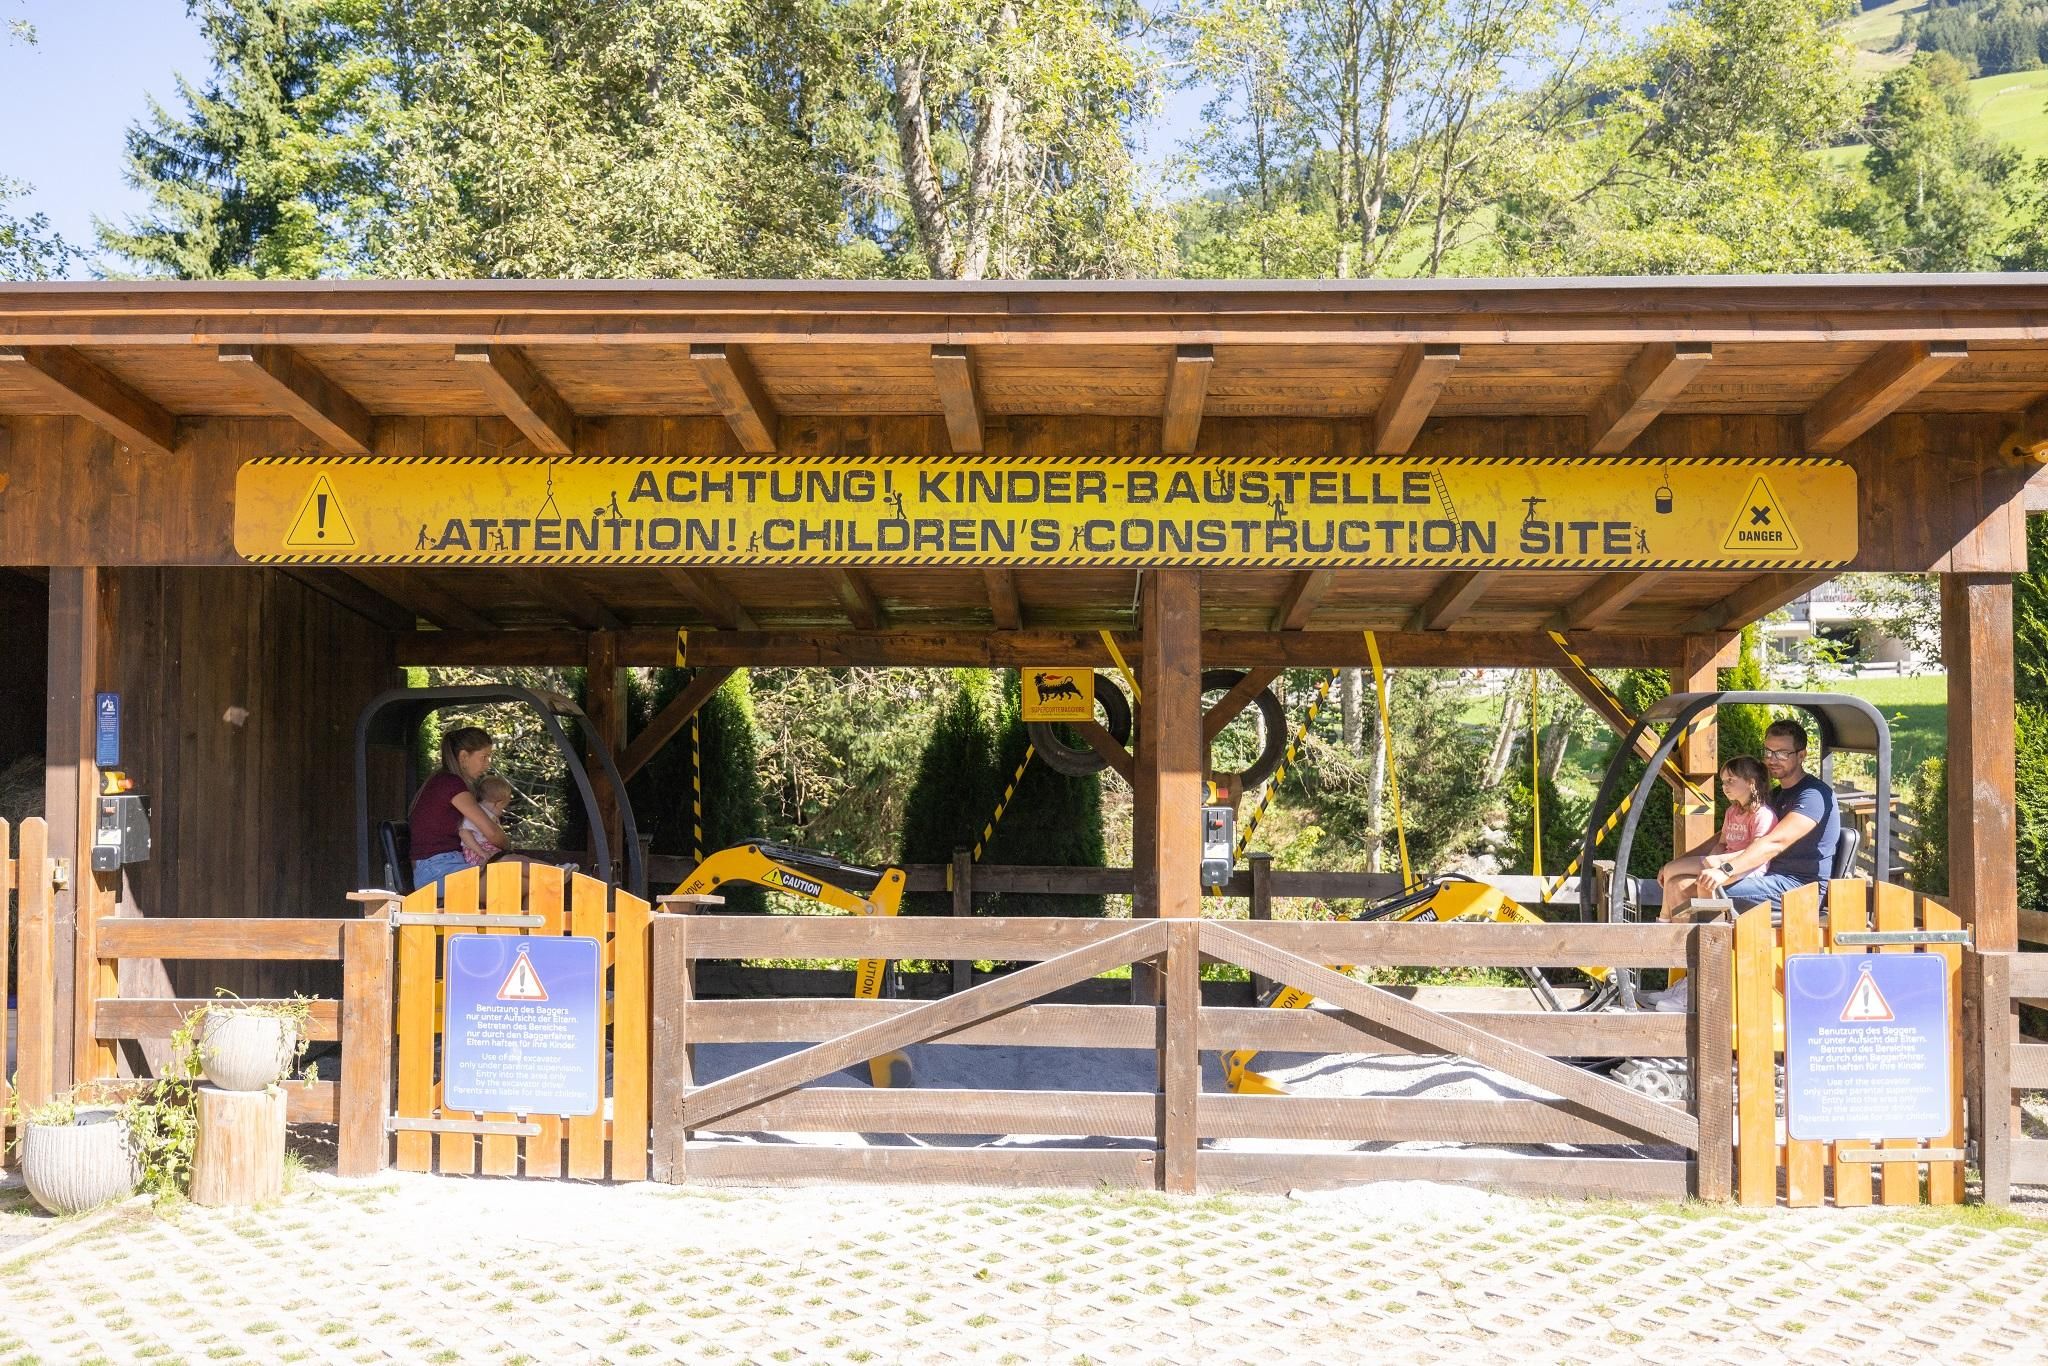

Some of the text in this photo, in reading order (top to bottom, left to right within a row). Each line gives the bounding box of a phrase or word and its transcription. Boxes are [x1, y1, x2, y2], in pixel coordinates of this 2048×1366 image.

[628, 469, 1431, 504] ACHTUNG! KINDER-BAUSTELLE
[436, 517, 1632, 555] ATTENTION! CHILDREN'S CONSTRUCTION SITE
[1739, 530, 1783, 542] DANGER
[782, 875, 821, 896] CAUTION
[476, 1004, 518, 1015] Benutzung
[537, 1006, 568, 1016] Baggers
[504, 1014, 536, 1022] Aufsicht
[513, 1022, 526, 1030] des
[529, 1023, 568, 1031] Bereiches
[1819, 1027, 1863, 1037] Benutzung
[1883, 1026, 1916, 1035] Baggers
[467, 1038, 489, 1046] Eltern
[492, 1039, 518, 1047] haften
[1849, 1035, 1883, 1043] Aufsicht
[1885, 1035, 1898, 1043] der
[1821, 1045, 1856, 1053] Betreten
[1876, 1044, 1915, 1052] Bereiches
[499, 1053, 507, 1061] of
[1826, 1054, 1850, 1062] durch
[1852, 1053, 1867, 1061] den
[503, 1063, 534, 1071] parental
[1810, 1063, 1834, 1072] Eltern
[1837, 1062, 1864, 1071] haften
[1866, 1062, 1877, 1070] für
[476, 1070, 496, 1079] Entry
[549, 1072, 566, 1080] only
[476, 1078, 485, 1087] by
[454, 1086, 481, 1095] Parents
